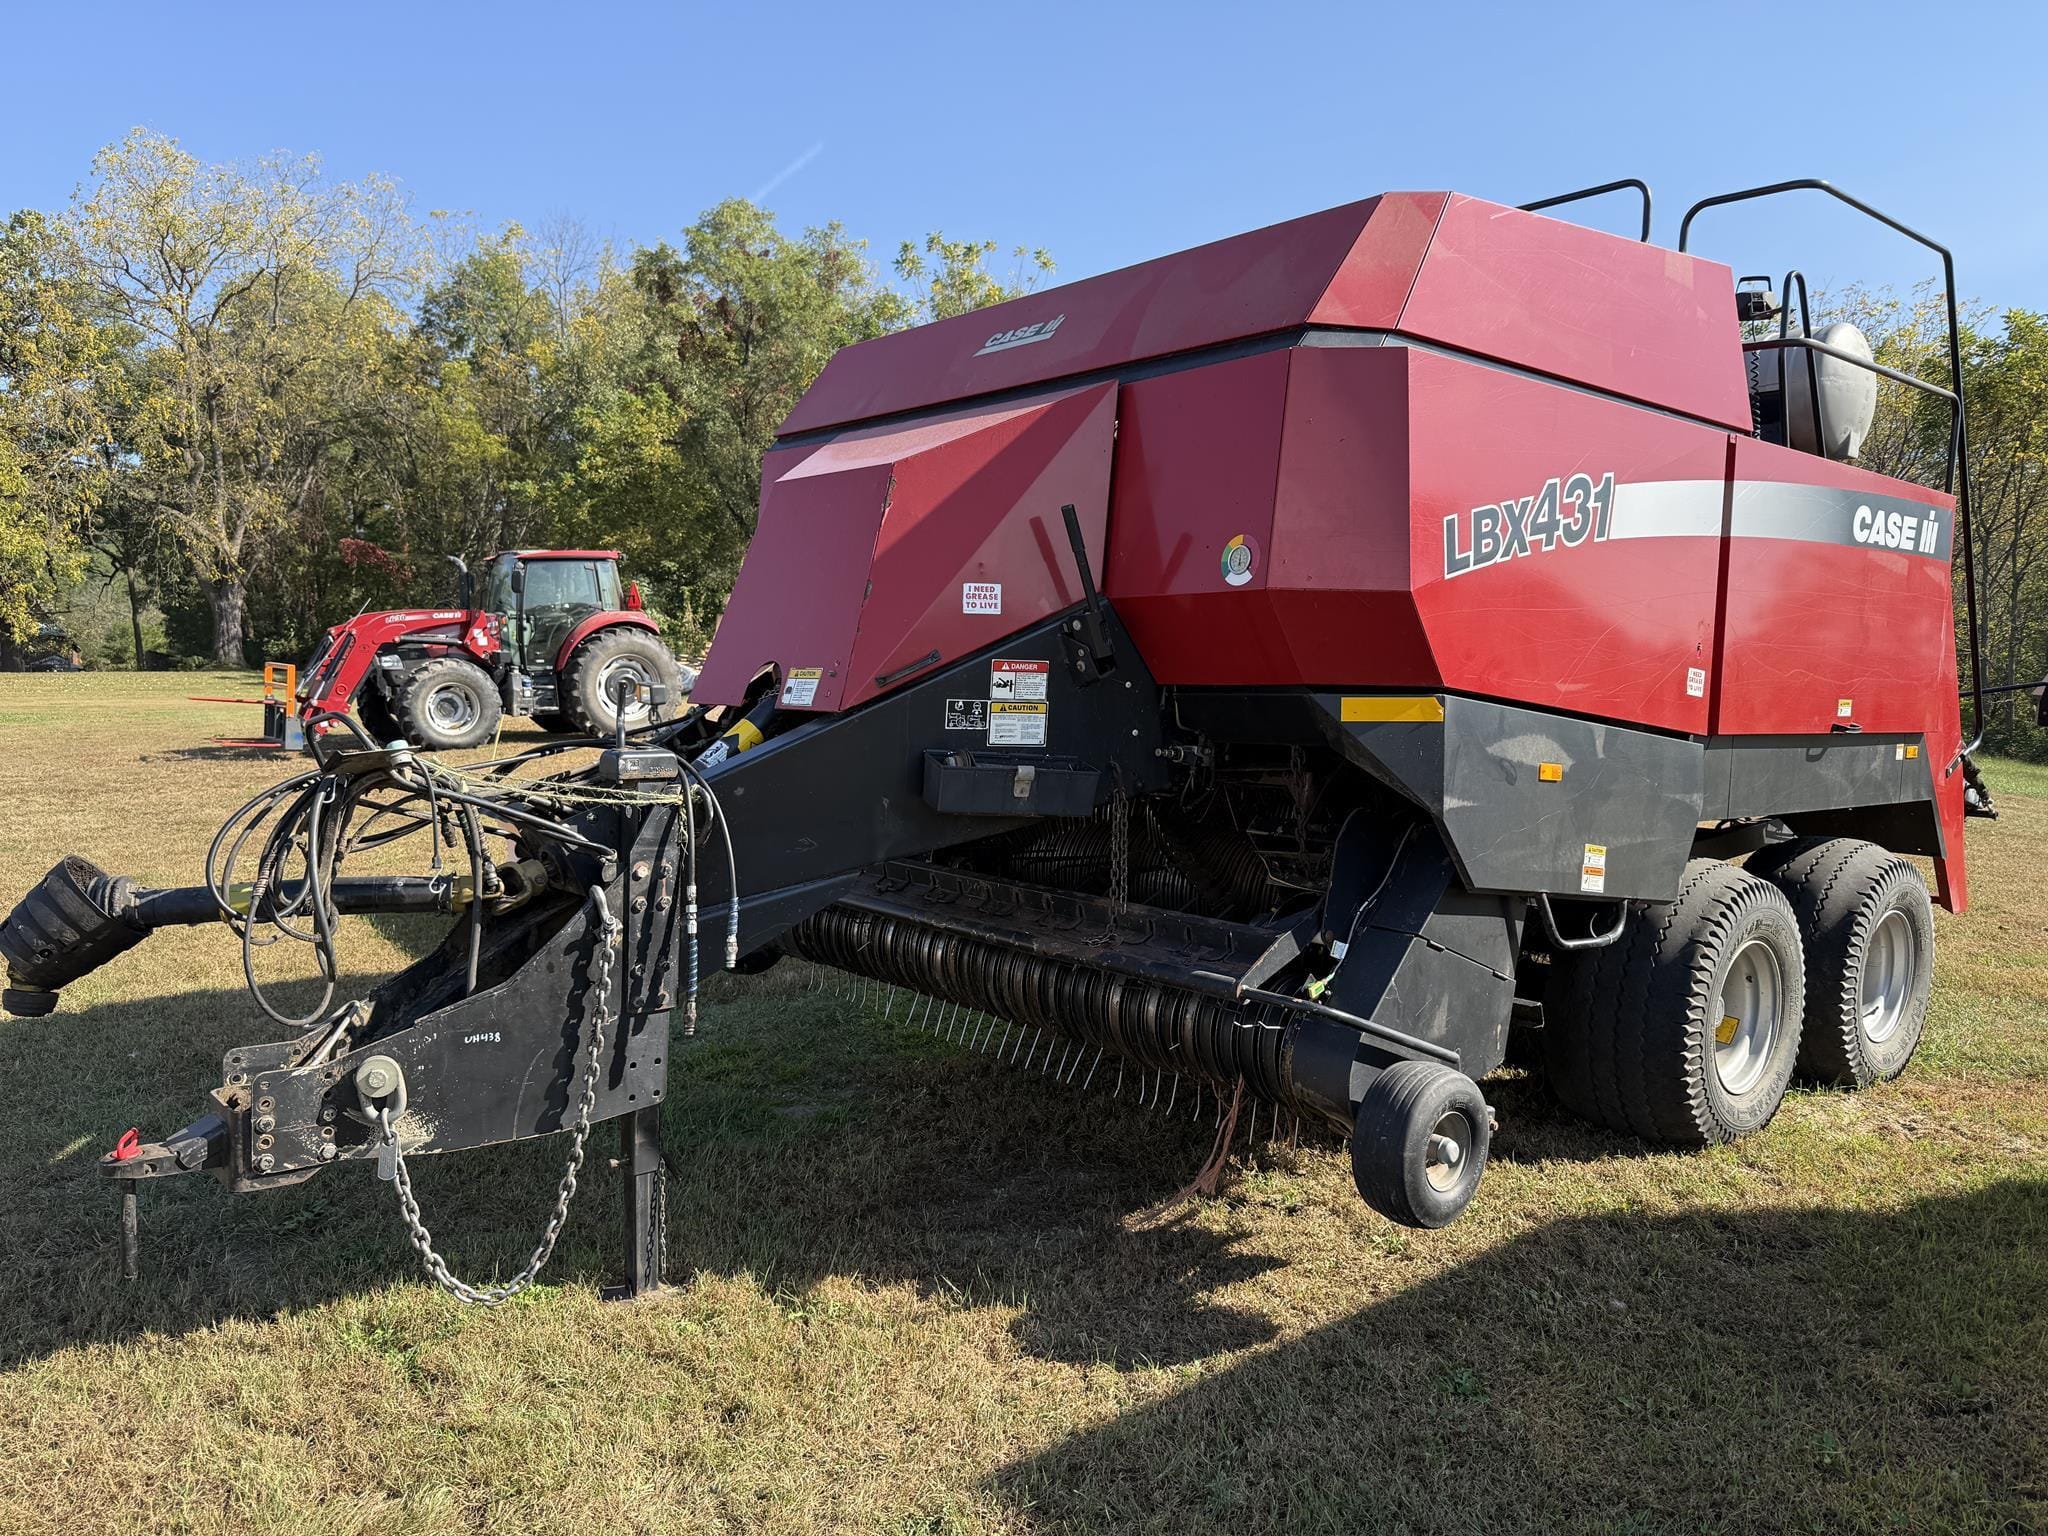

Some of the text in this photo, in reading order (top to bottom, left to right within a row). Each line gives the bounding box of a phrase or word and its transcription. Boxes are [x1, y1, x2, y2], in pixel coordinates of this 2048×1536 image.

[985, 322, 1044, 347] CASE
[1443, 471, 1615, 580] LBX431
[1852, 504, 1918, 551] CASE
[973, 585, 996, 593] NEED
[965, 593, 999, 601] GREASE
[965, 601, 977, 609] TO
[1010, 663, 1038, 671] DANGER
